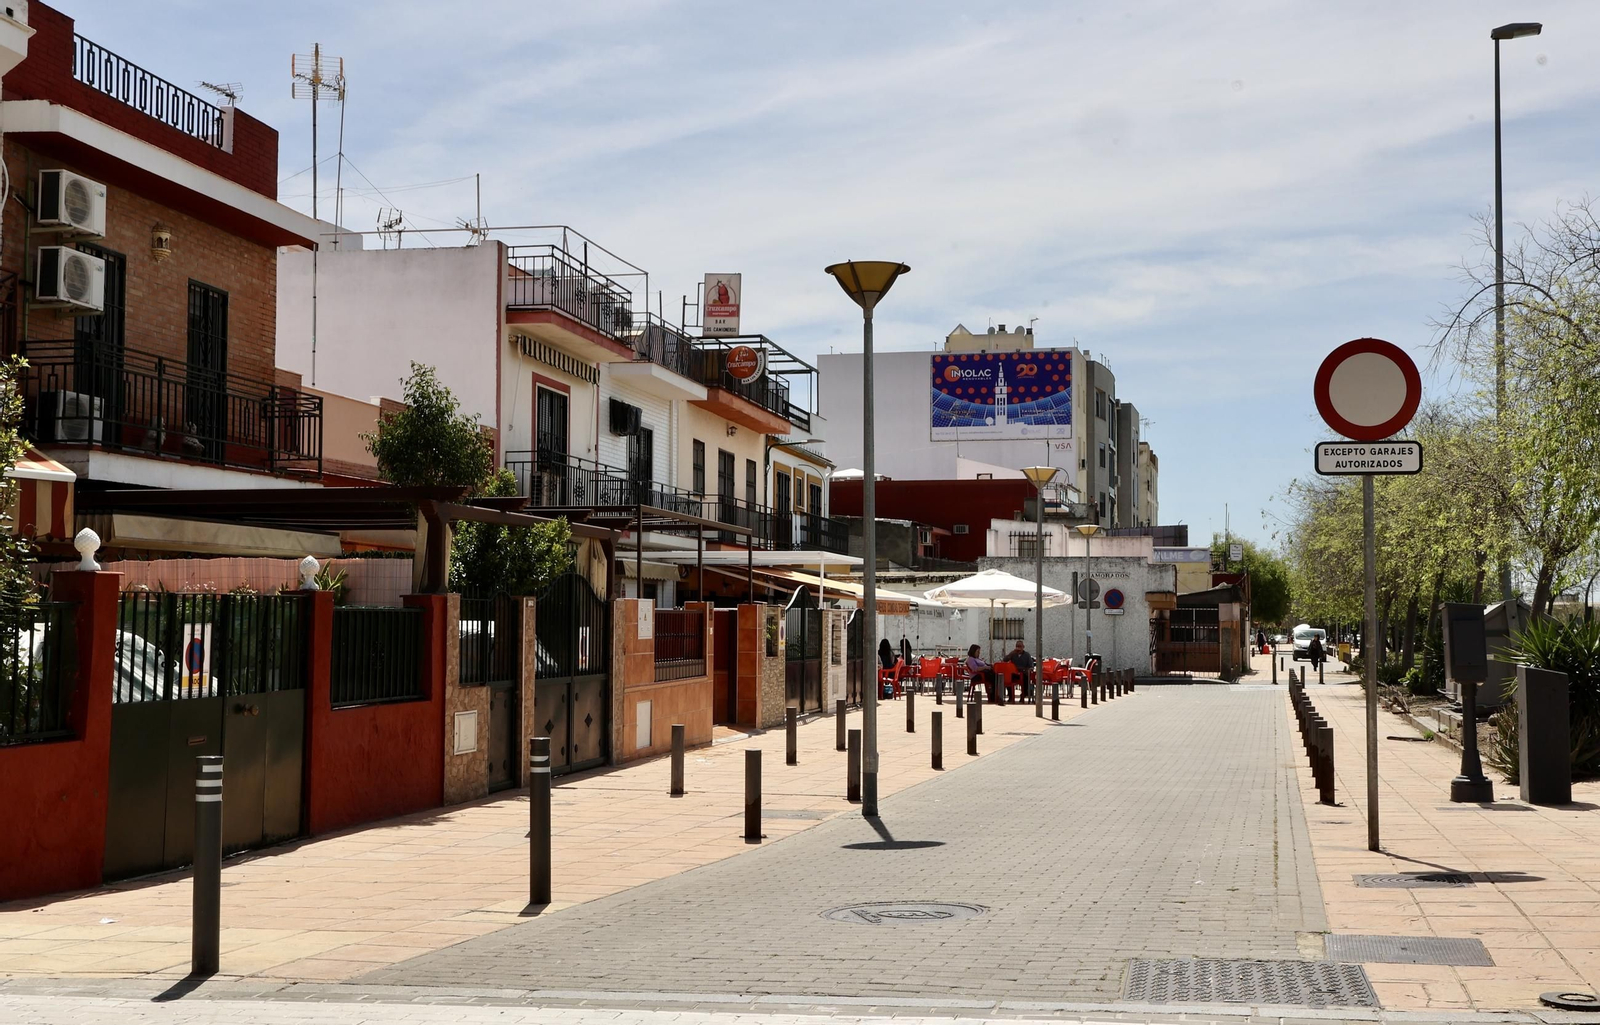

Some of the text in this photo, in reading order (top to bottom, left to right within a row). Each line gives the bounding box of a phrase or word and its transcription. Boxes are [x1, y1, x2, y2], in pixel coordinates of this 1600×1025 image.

[951, 363, 1038, 378] INSOLAC 20
[1324, 447, 1414, 456] EXCEPTO GARAJES
[1335, 460, 1403, 468] AUTORIZADOS
